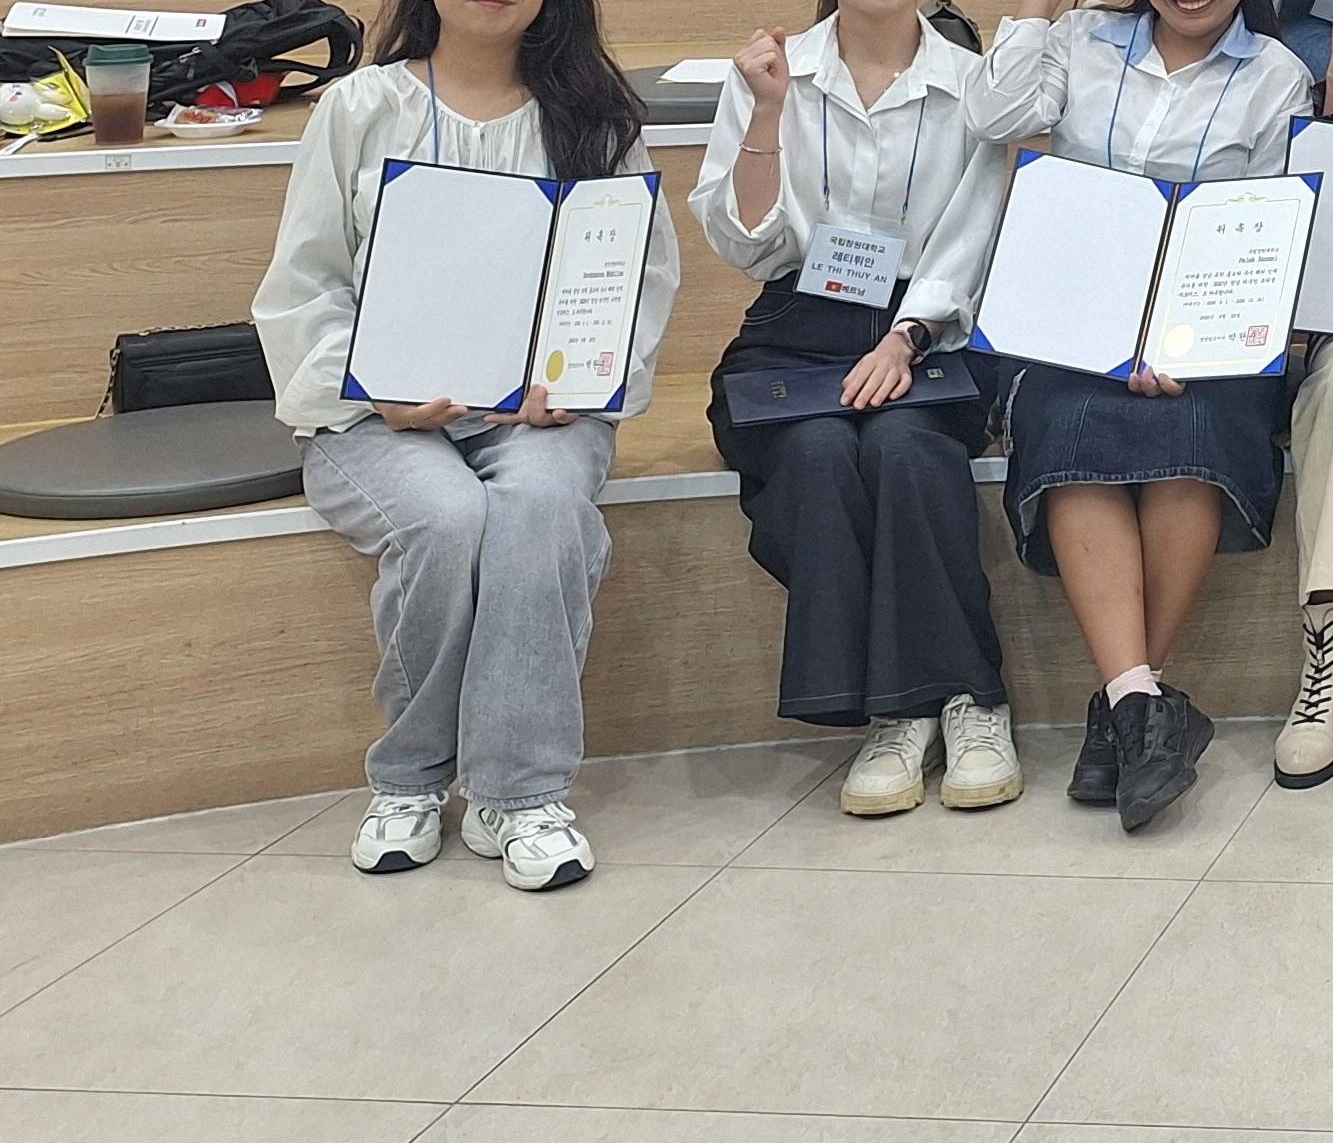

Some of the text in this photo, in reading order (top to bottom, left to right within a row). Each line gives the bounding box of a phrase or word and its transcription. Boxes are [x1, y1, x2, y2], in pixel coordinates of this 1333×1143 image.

[830, 236, 886, 254] 국립창원대학교
[811, 262, 887, 283] LE THI THUY AN
[842, 285, 866, 297] 베트남
